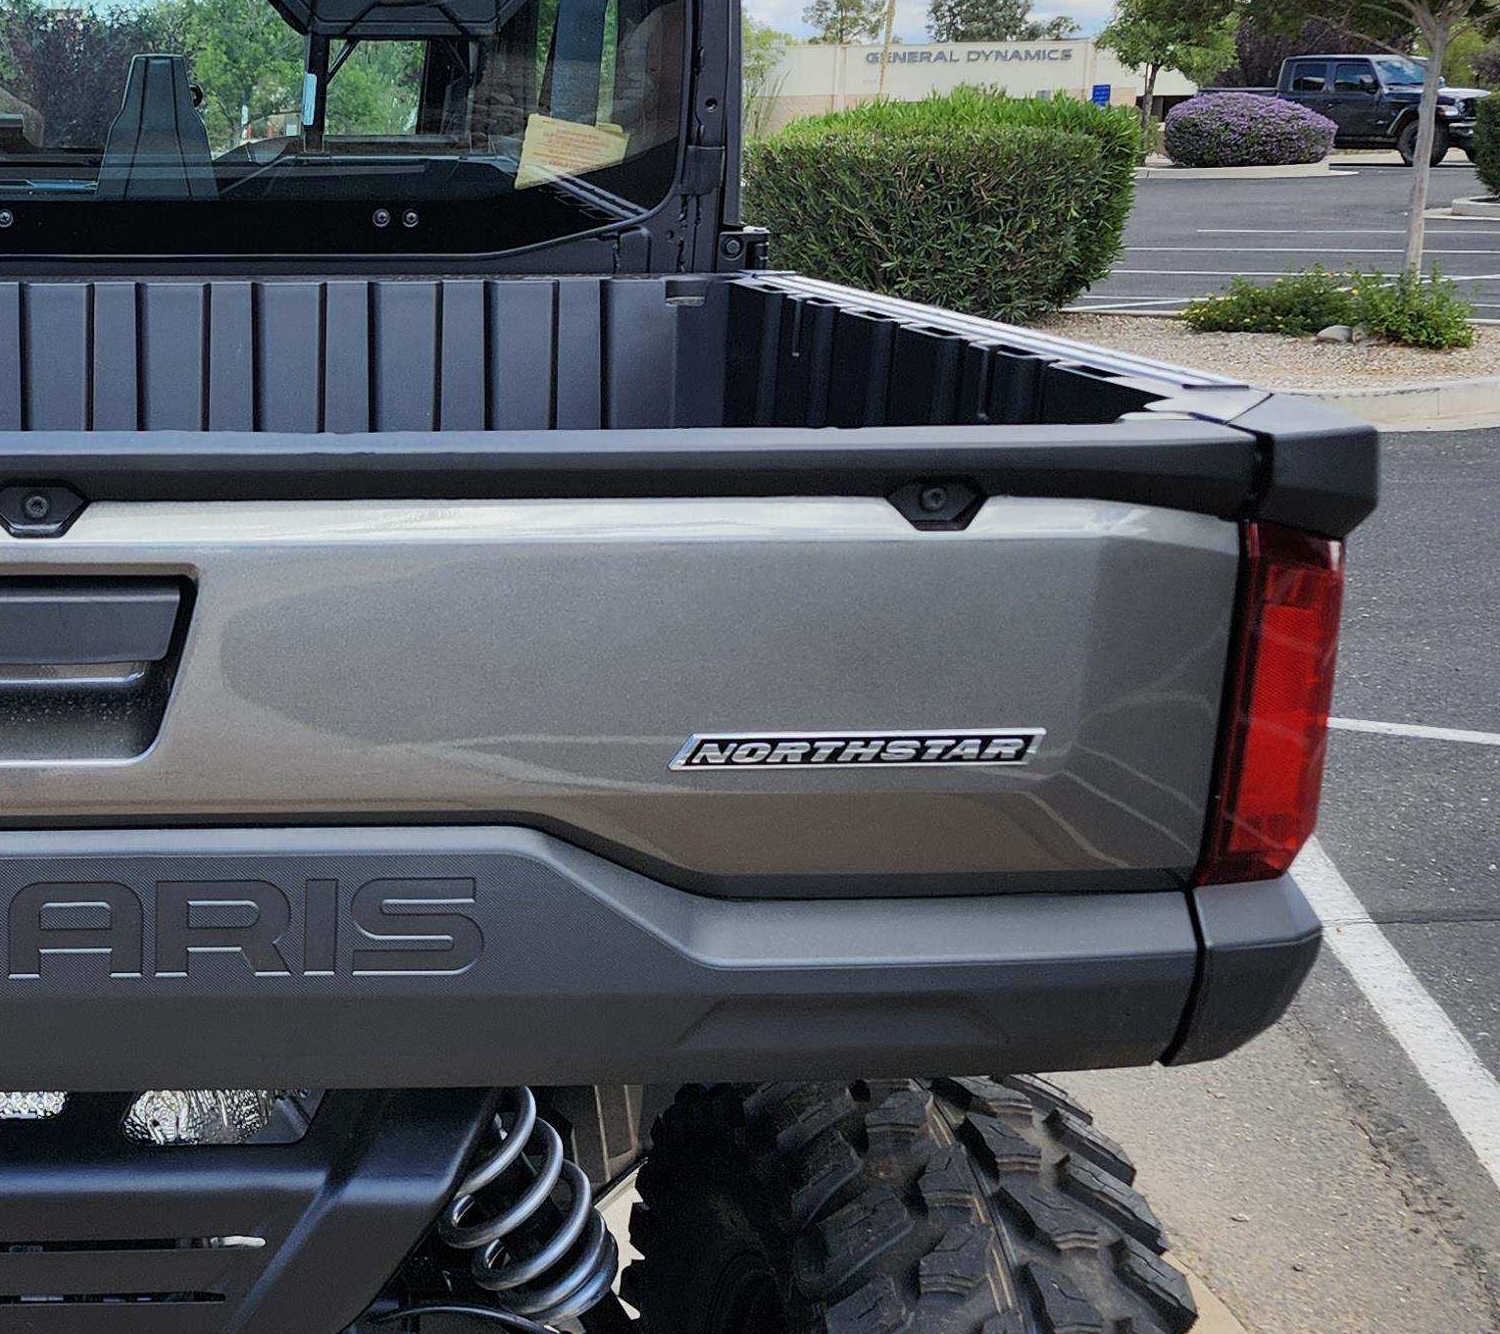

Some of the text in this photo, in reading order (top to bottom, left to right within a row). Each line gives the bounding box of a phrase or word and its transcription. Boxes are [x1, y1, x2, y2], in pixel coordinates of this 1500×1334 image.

[866, 49, 1073, 64] GENERAL DYNAMICS
[691, 738, 1025, 764] NORTHSTAR
